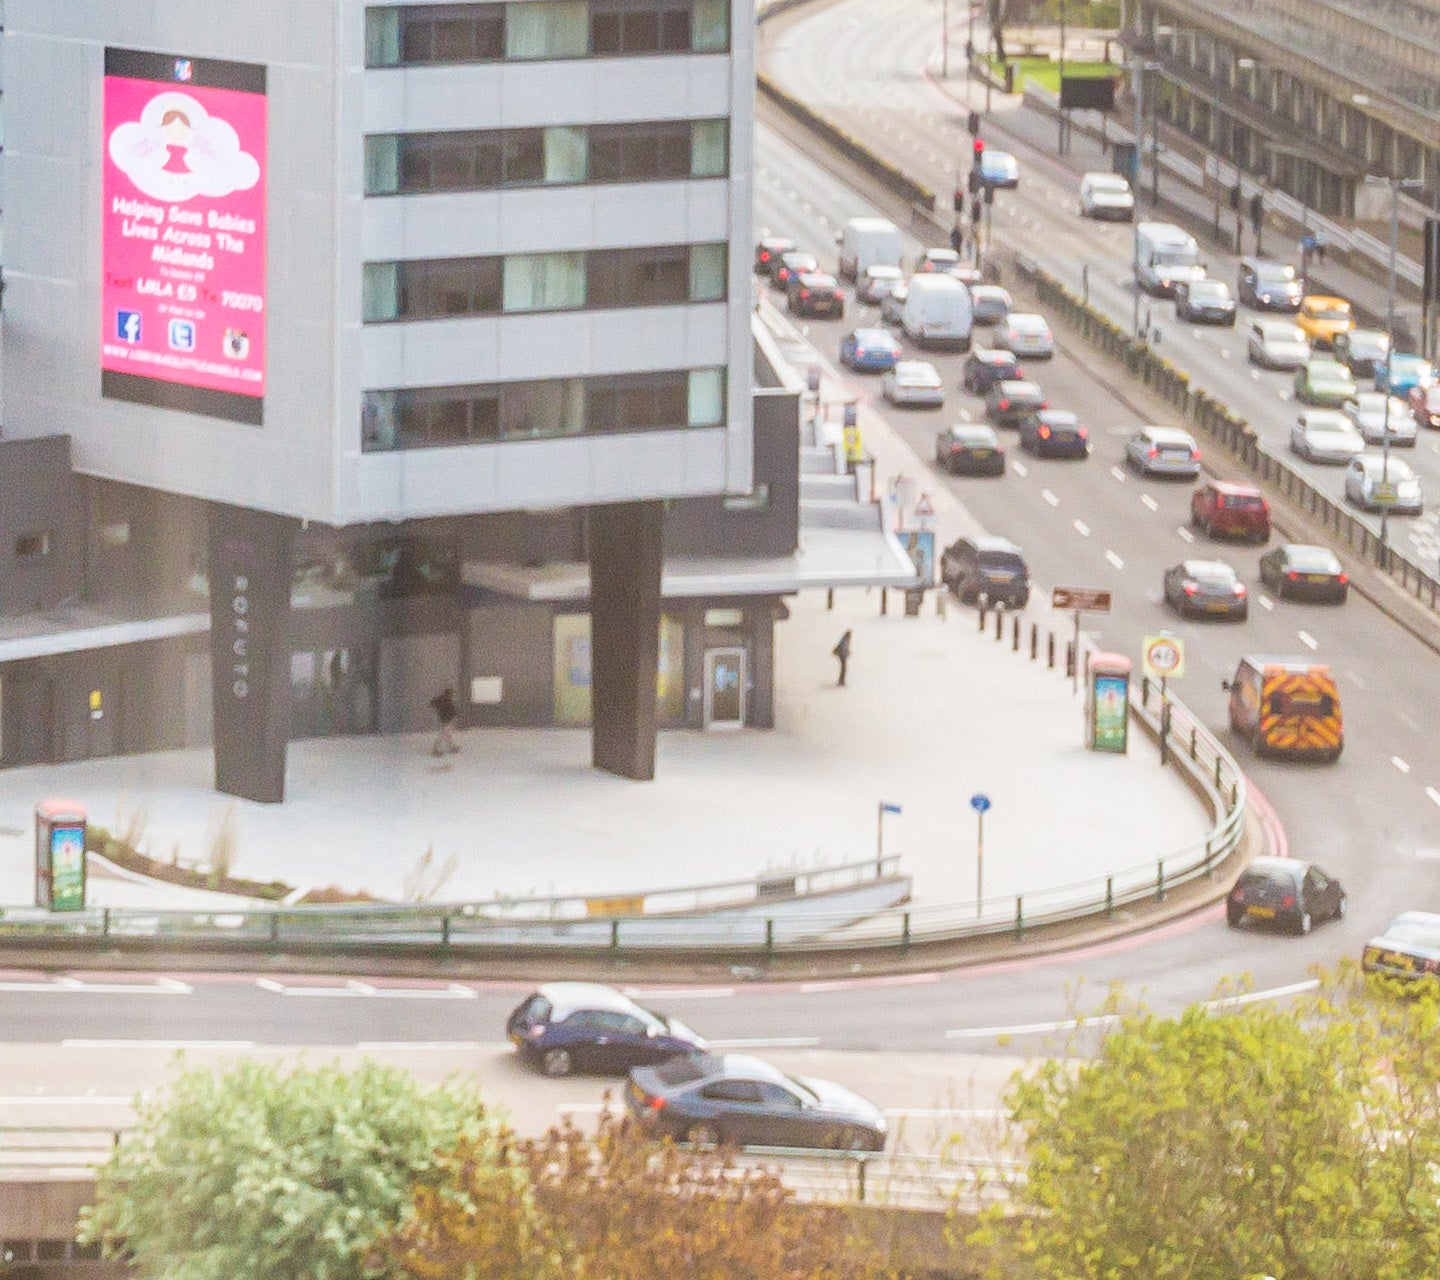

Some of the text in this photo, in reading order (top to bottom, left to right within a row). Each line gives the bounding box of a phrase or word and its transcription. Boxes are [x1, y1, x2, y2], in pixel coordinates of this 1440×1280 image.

[112, 197, 256, 234] Helping Save Babies
[122, 218, 245, 253] Lives Across The
[151, 244, 214, 270] Midlands
[221, 290, 264, 313] 70070
